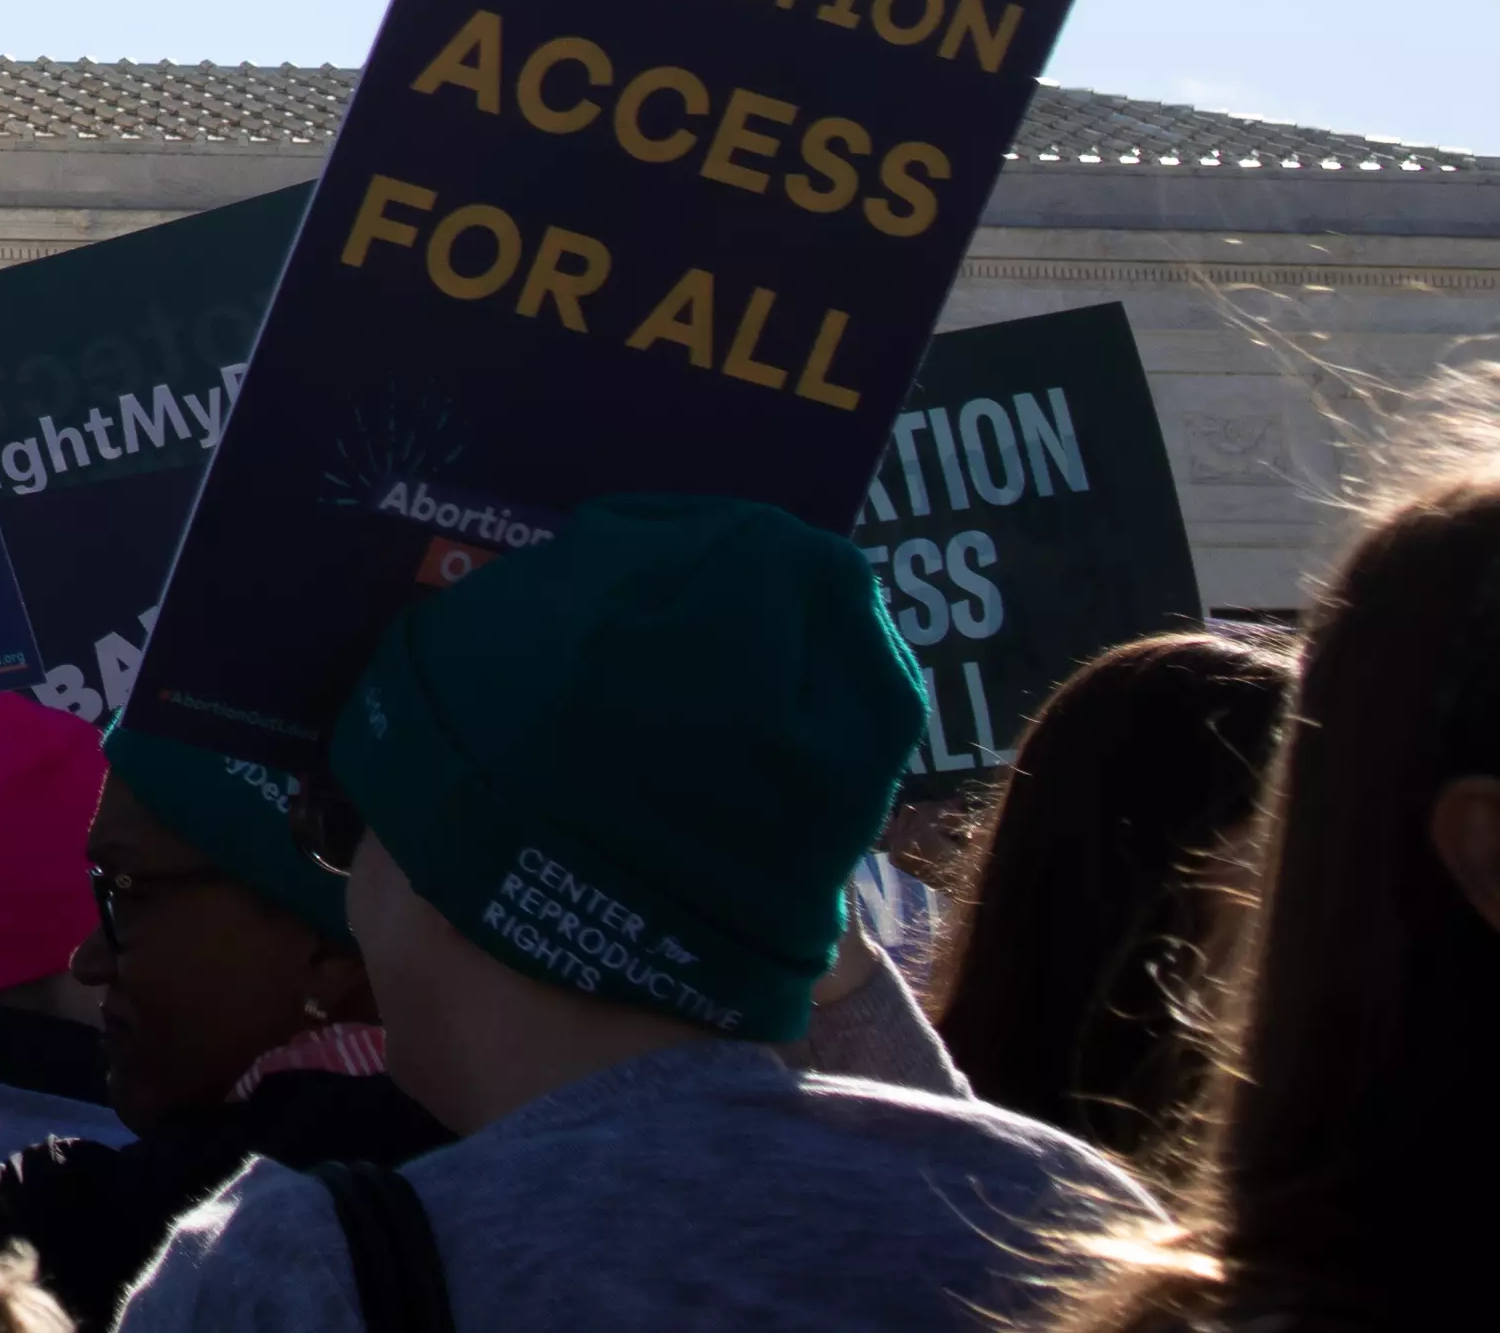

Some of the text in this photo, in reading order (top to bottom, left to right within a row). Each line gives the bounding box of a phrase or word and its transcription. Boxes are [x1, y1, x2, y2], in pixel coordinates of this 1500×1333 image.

[410, 8, 952, 238] ACCESS
[340, 173, 861, 412] FOR ALL
[481, 900, 601, 992] RIGHTS
[502, 872, 743, 1031] REPRODUCTIVE
[518, 847, 645, 942] CENTER
